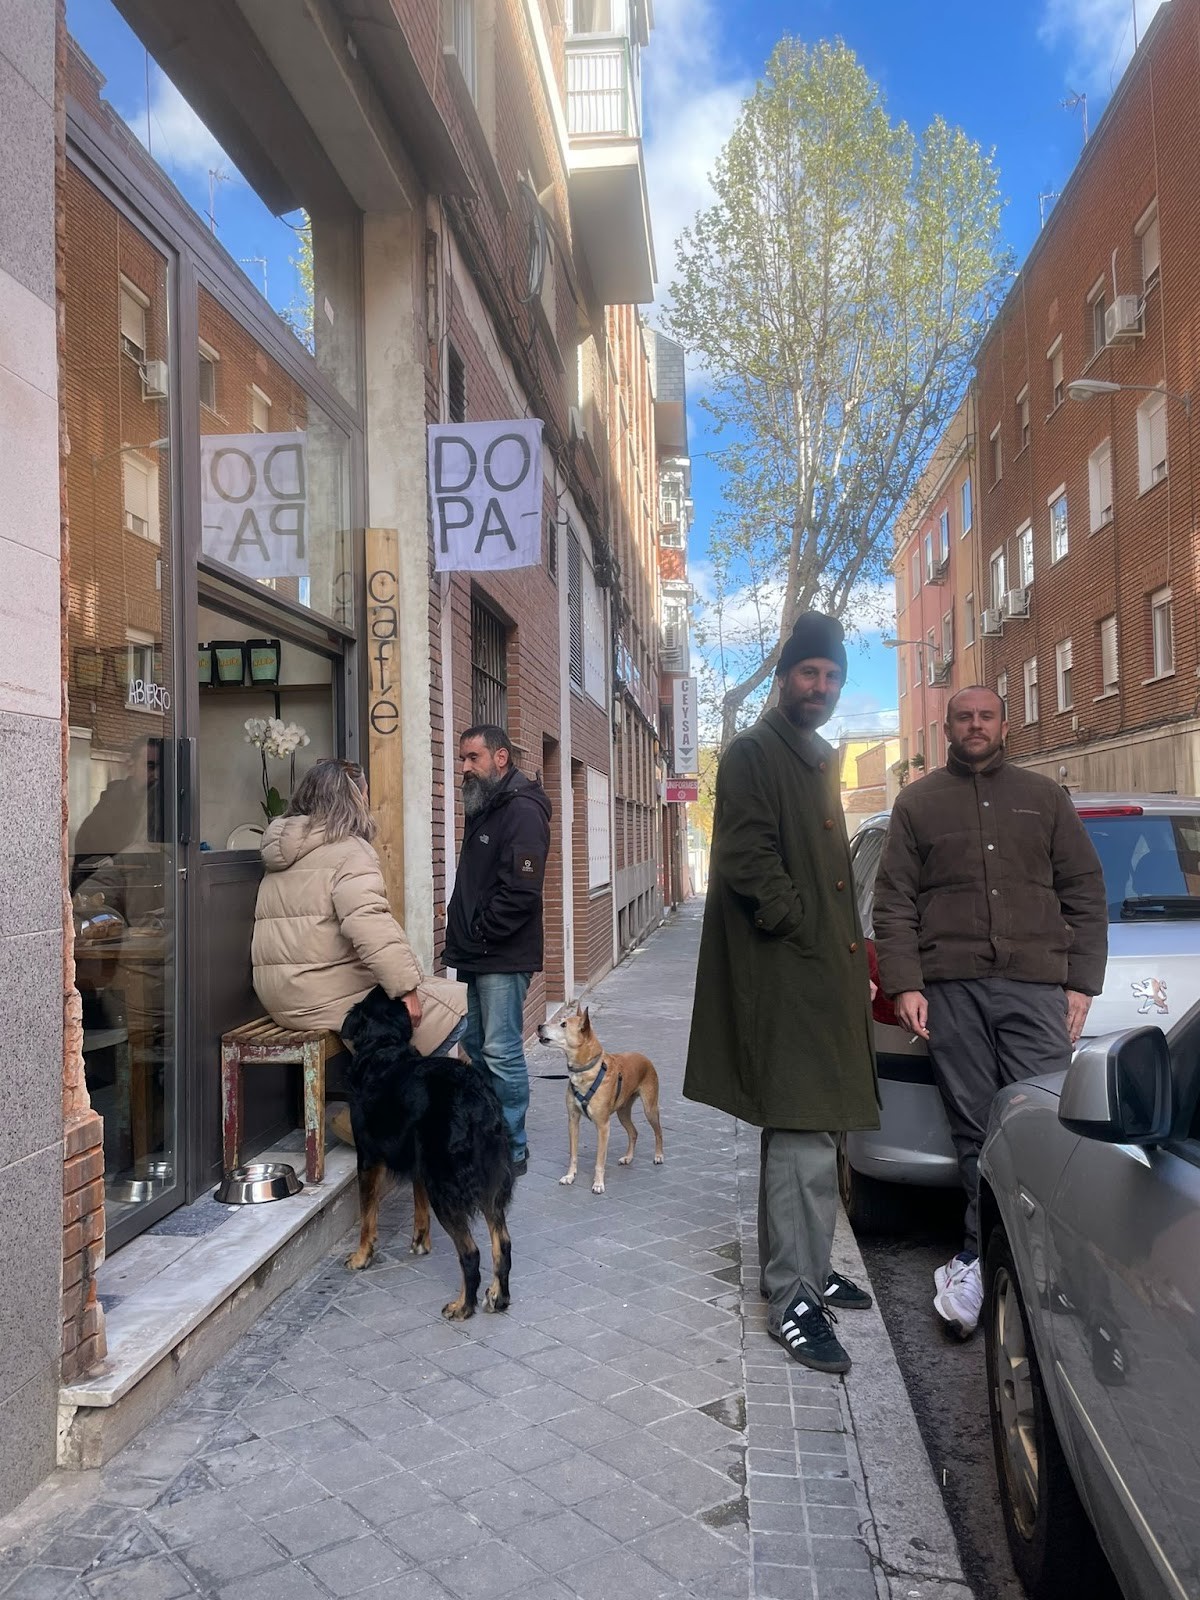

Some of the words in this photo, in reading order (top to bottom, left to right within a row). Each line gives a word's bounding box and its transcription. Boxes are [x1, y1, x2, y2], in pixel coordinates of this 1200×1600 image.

[434, 433, 531, 494] DO
[128, 678, 171, 711] ABIERTO
[681, 680, 690, 745] CEYSA
